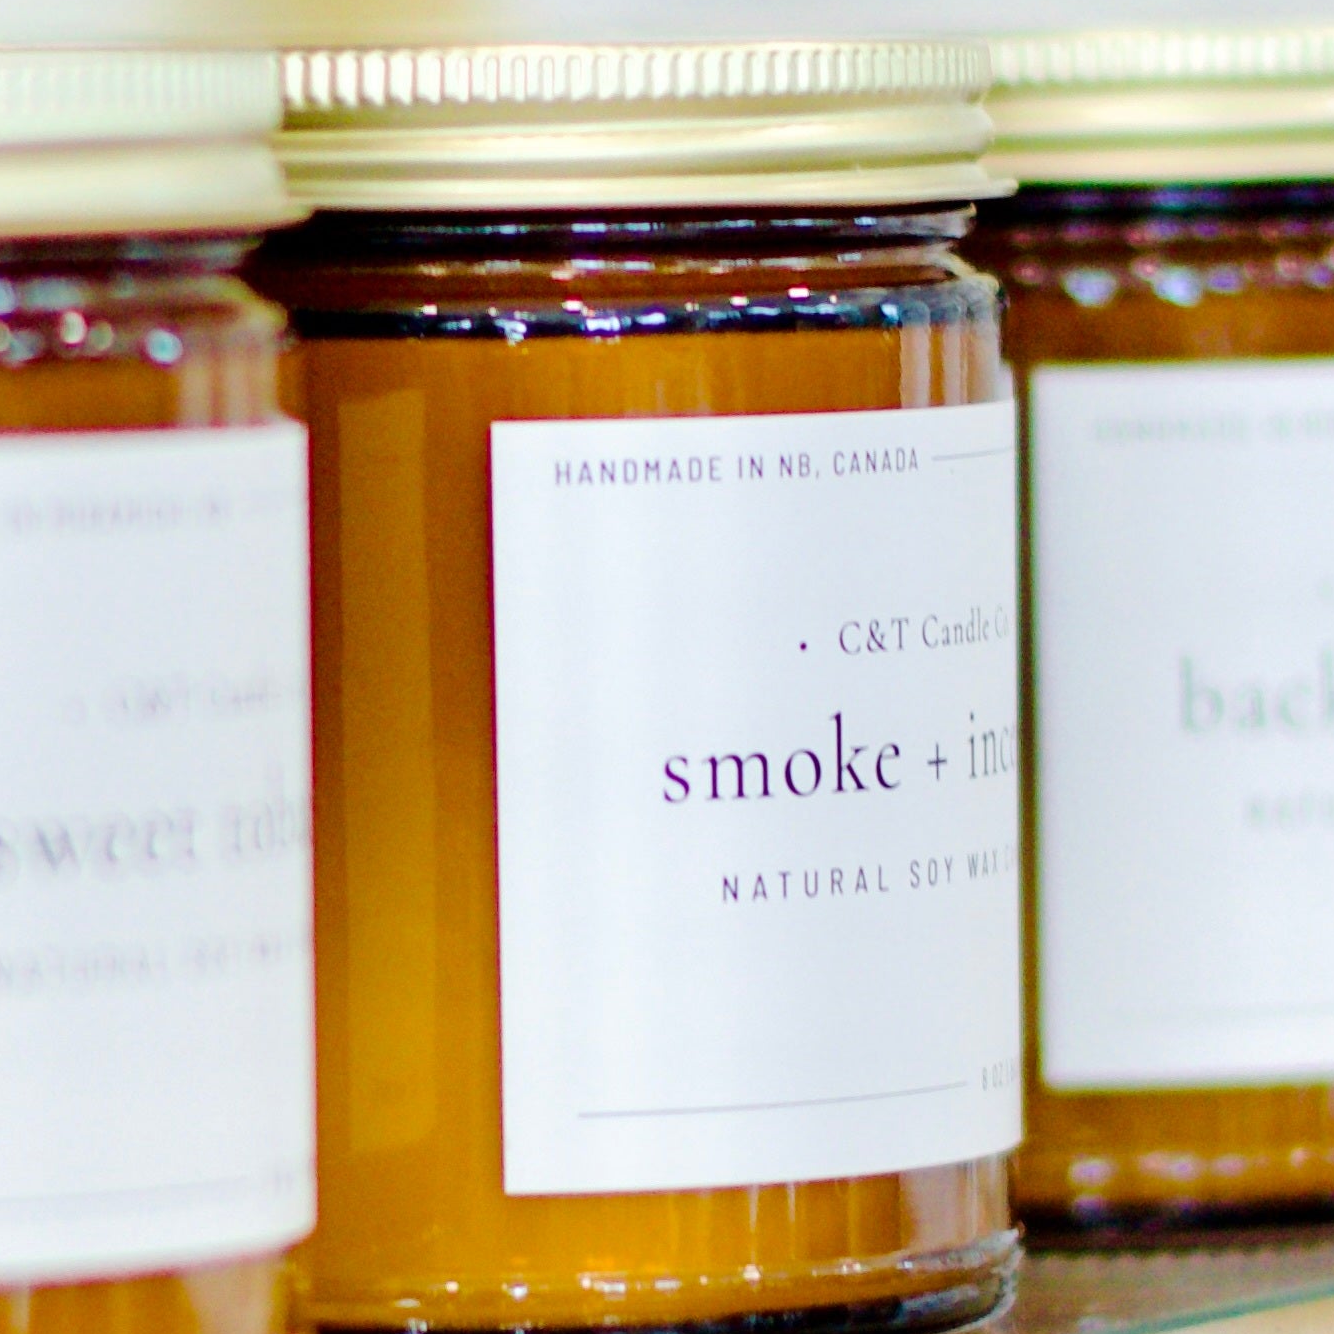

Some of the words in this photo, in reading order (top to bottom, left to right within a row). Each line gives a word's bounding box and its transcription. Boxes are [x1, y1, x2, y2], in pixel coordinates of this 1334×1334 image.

[553, 454, 723, 486] HANDMADE
[737, 454, 764, 480] IN
[778, 451, 820, 481] NB,
[832, 446, 919, 477] CANADA
[838, 616, 910, 656] C&T
[921, 605, 990, 650] Candle
[661, 710, 902, 804] smoke
[926, 742, 949, 781] +
[721, 863, 890, 904] NATURAL
[909, 855, 954, 890] SOY
[966, 848, 999, 880] WAX
